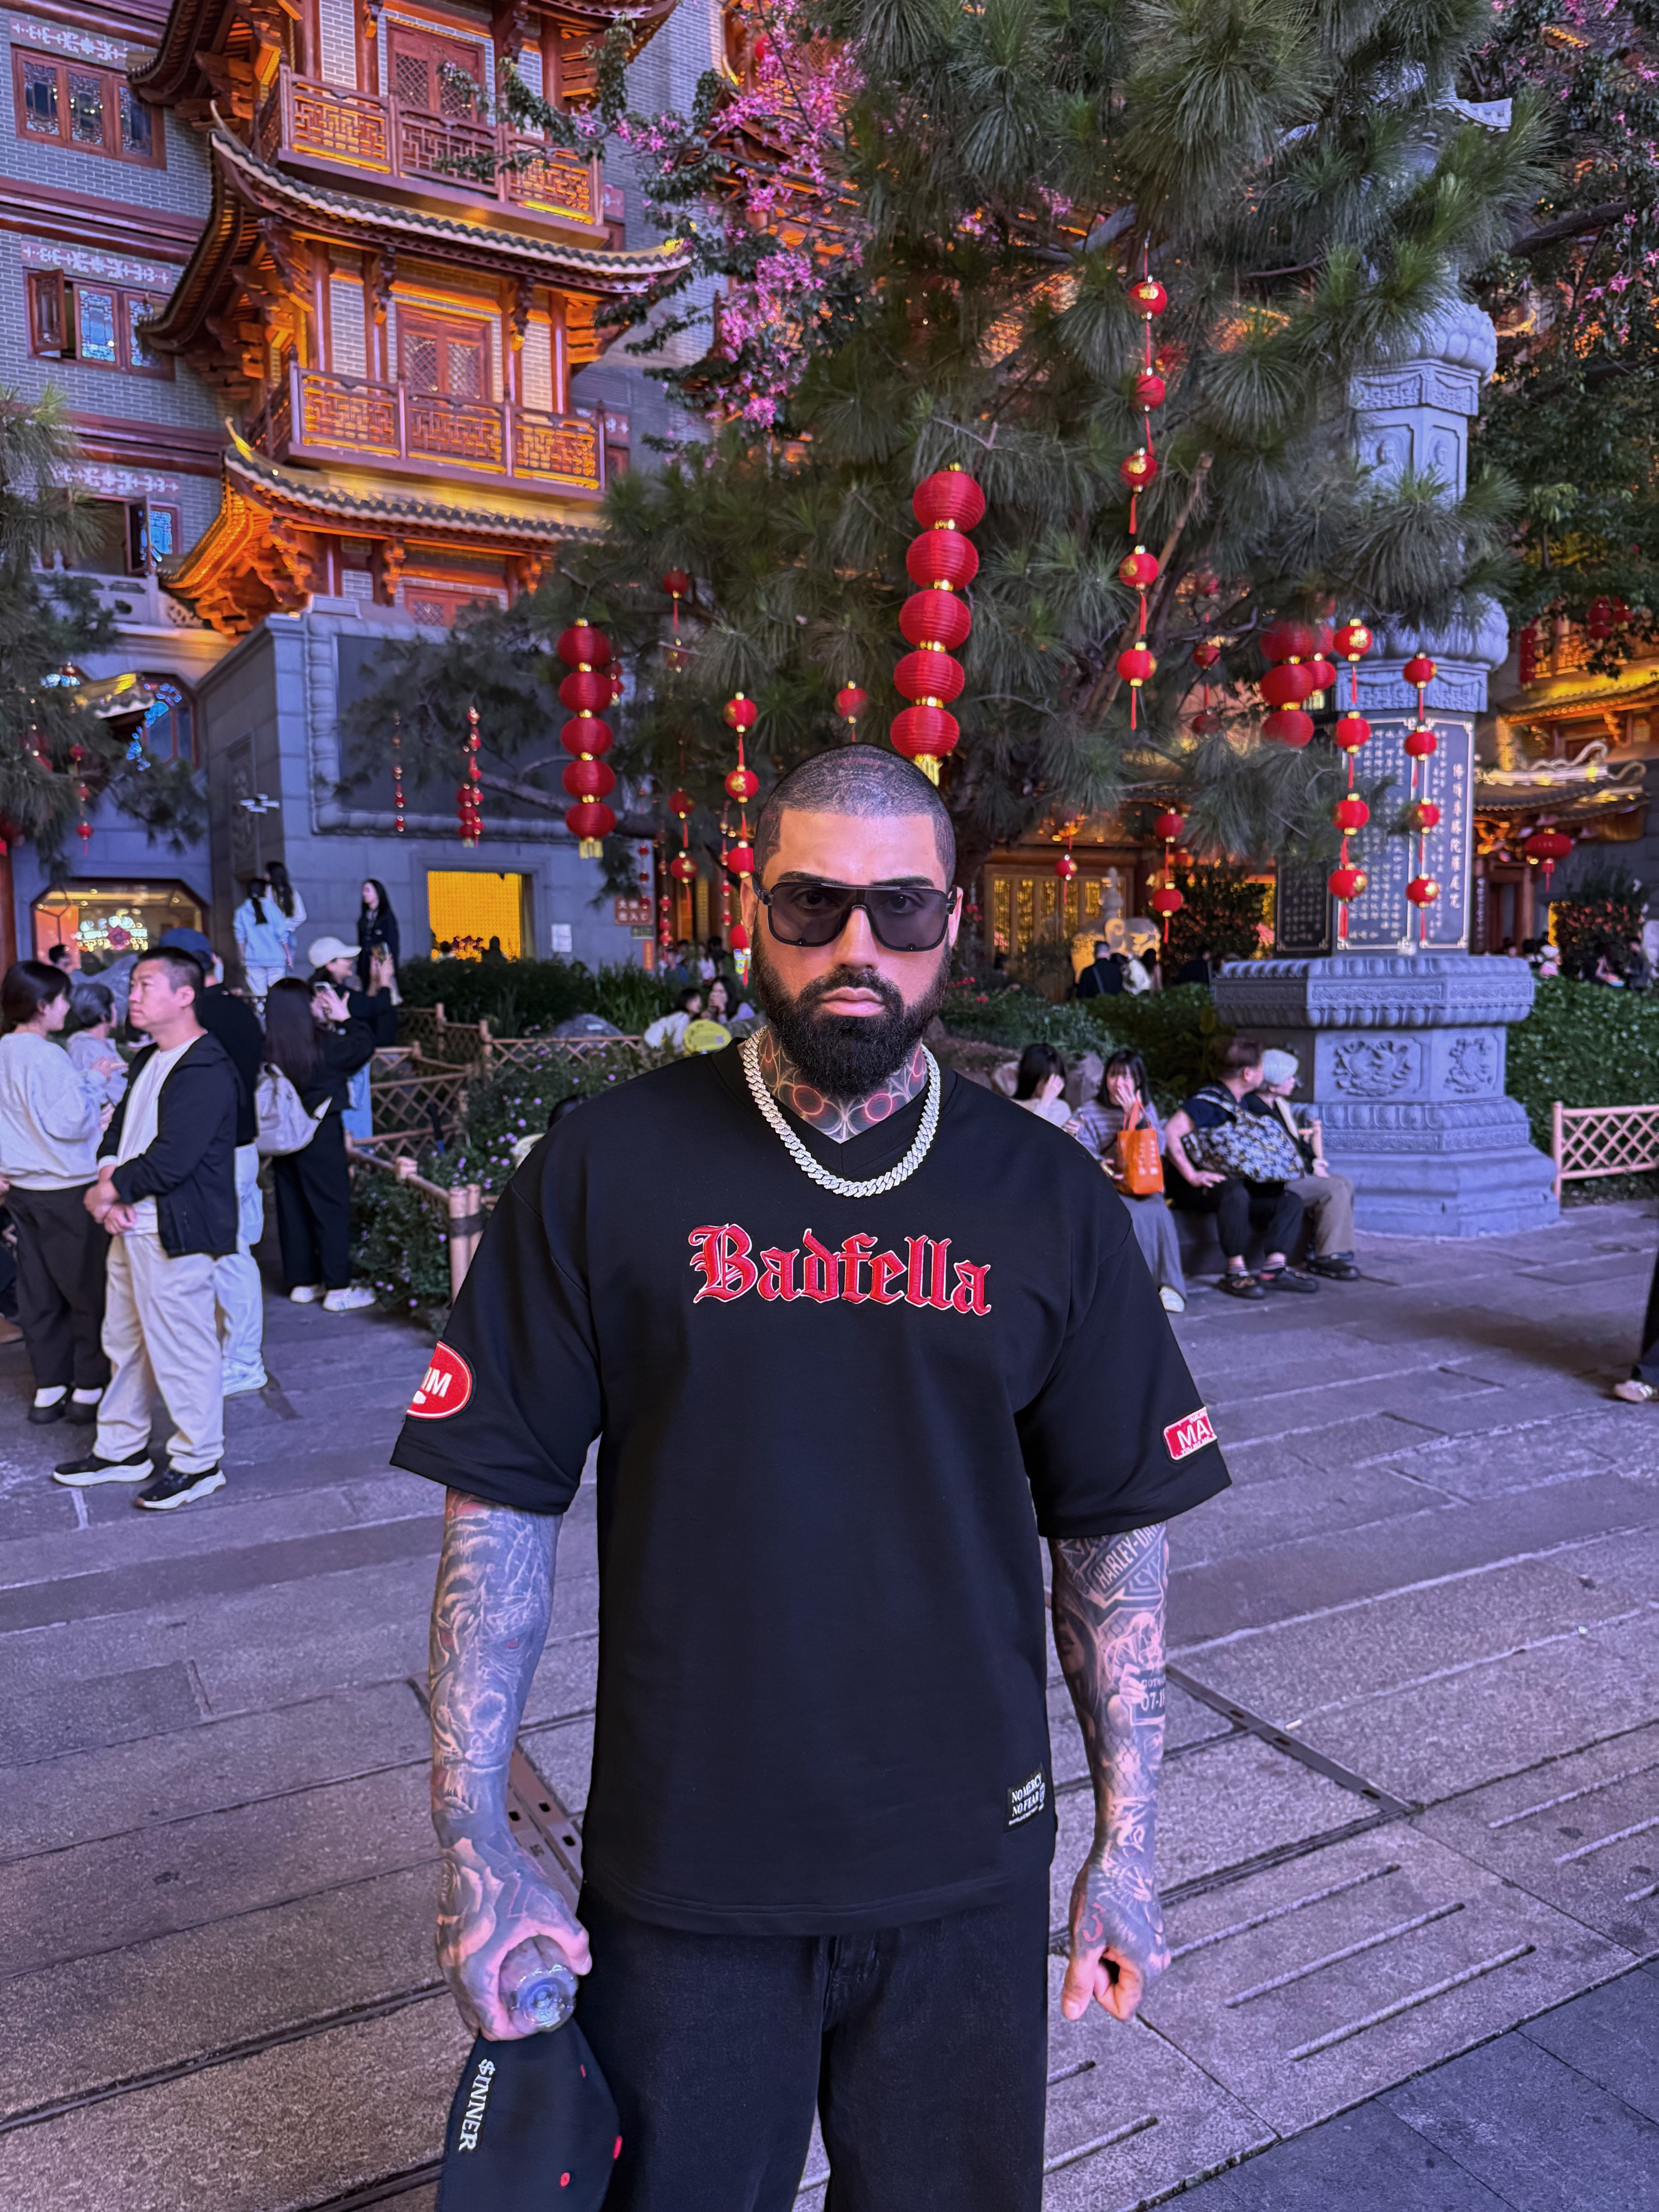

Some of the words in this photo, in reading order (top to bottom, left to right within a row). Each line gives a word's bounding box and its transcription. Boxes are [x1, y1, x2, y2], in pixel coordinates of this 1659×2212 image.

[688, 1223, 991, 1316] Badfella
[1012, 1789, 1023, 1803] NO
[1012, 1803, 1023, 1817] NO
